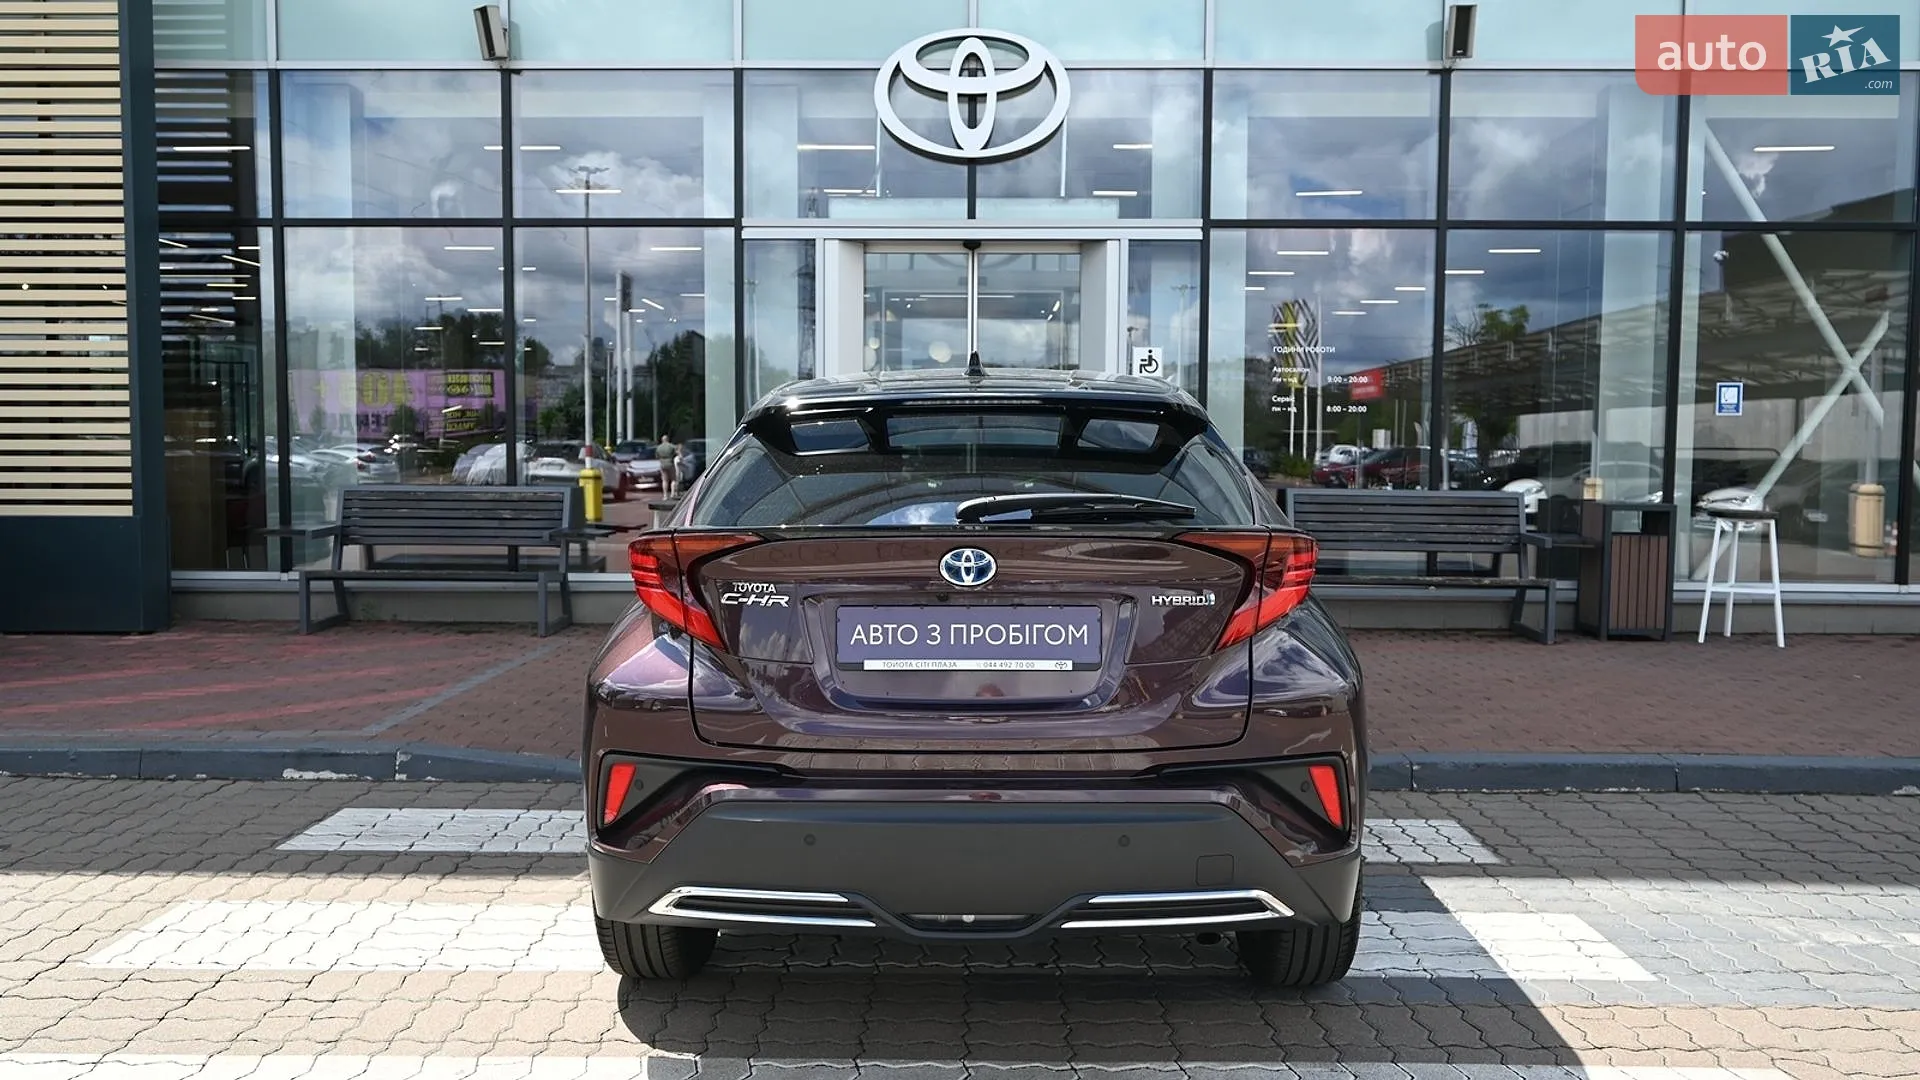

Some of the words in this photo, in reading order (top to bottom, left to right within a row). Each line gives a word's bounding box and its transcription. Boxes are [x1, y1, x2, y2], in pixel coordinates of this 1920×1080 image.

[732, 582, 777, 594] TOYOTA
[721, 593, 789, 608] C-HR
[1151, 595, 1207, 606] HYBRID
[850, 624, 918, 645] АВТО
[950, 624, 1088, 645] ПРОБІГОМ
